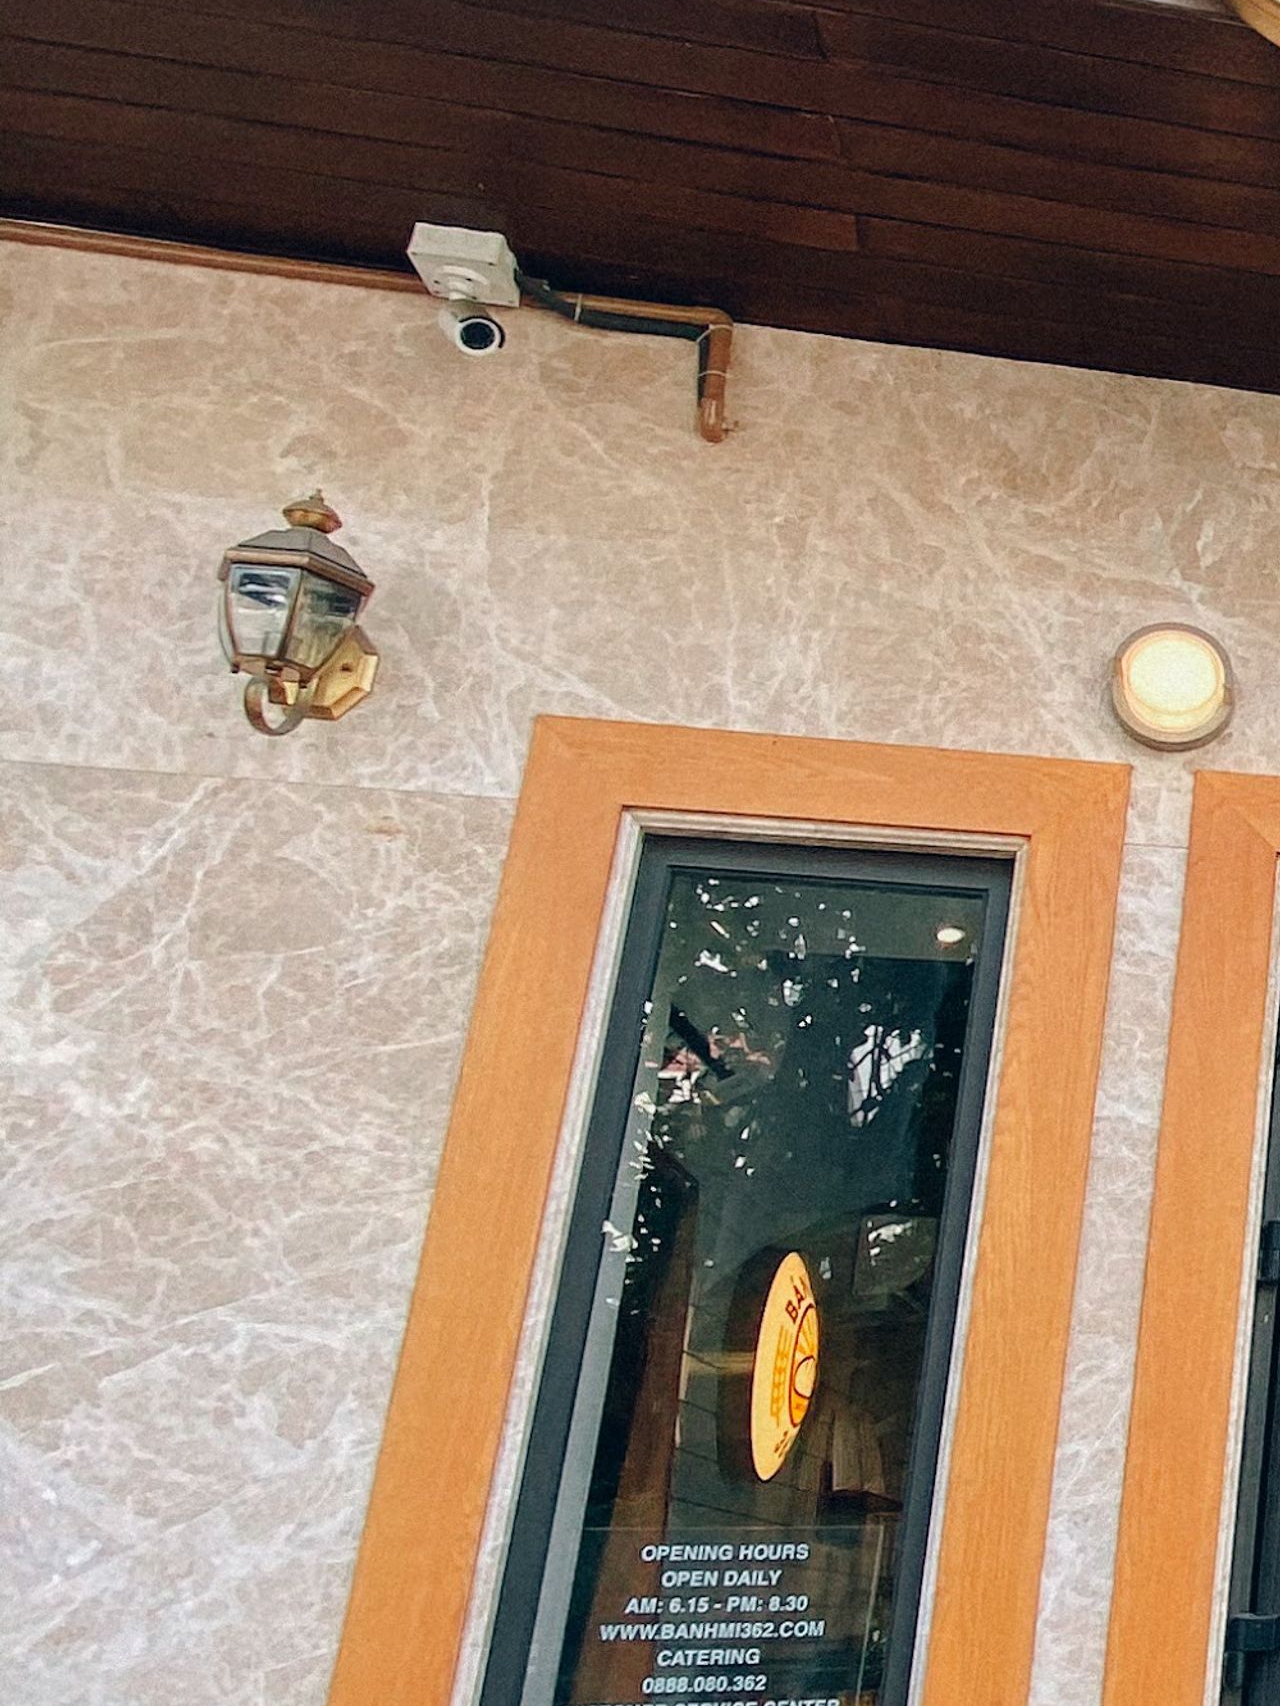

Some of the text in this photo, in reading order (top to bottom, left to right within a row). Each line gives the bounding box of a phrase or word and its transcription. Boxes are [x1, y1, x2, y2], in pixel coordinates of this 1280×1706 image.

[641, 1543, 810, 1562] OPENING HOURS
[661, 1570, 782, 1588] OPEN DAILY
[625, 1598, 664, 1615] AM:
[668, 1597, 709, 1614] 6.15
[726, 1596, 764, 1613] PM:
[769, 1595, 809, 1612] 8.30
[600, 1620, 826, 1642] WWW.BANHMI362.COM
[657, 1648, 761, 1667] CATERING
[642, 1675, 767, 1694] 0888.080.362
